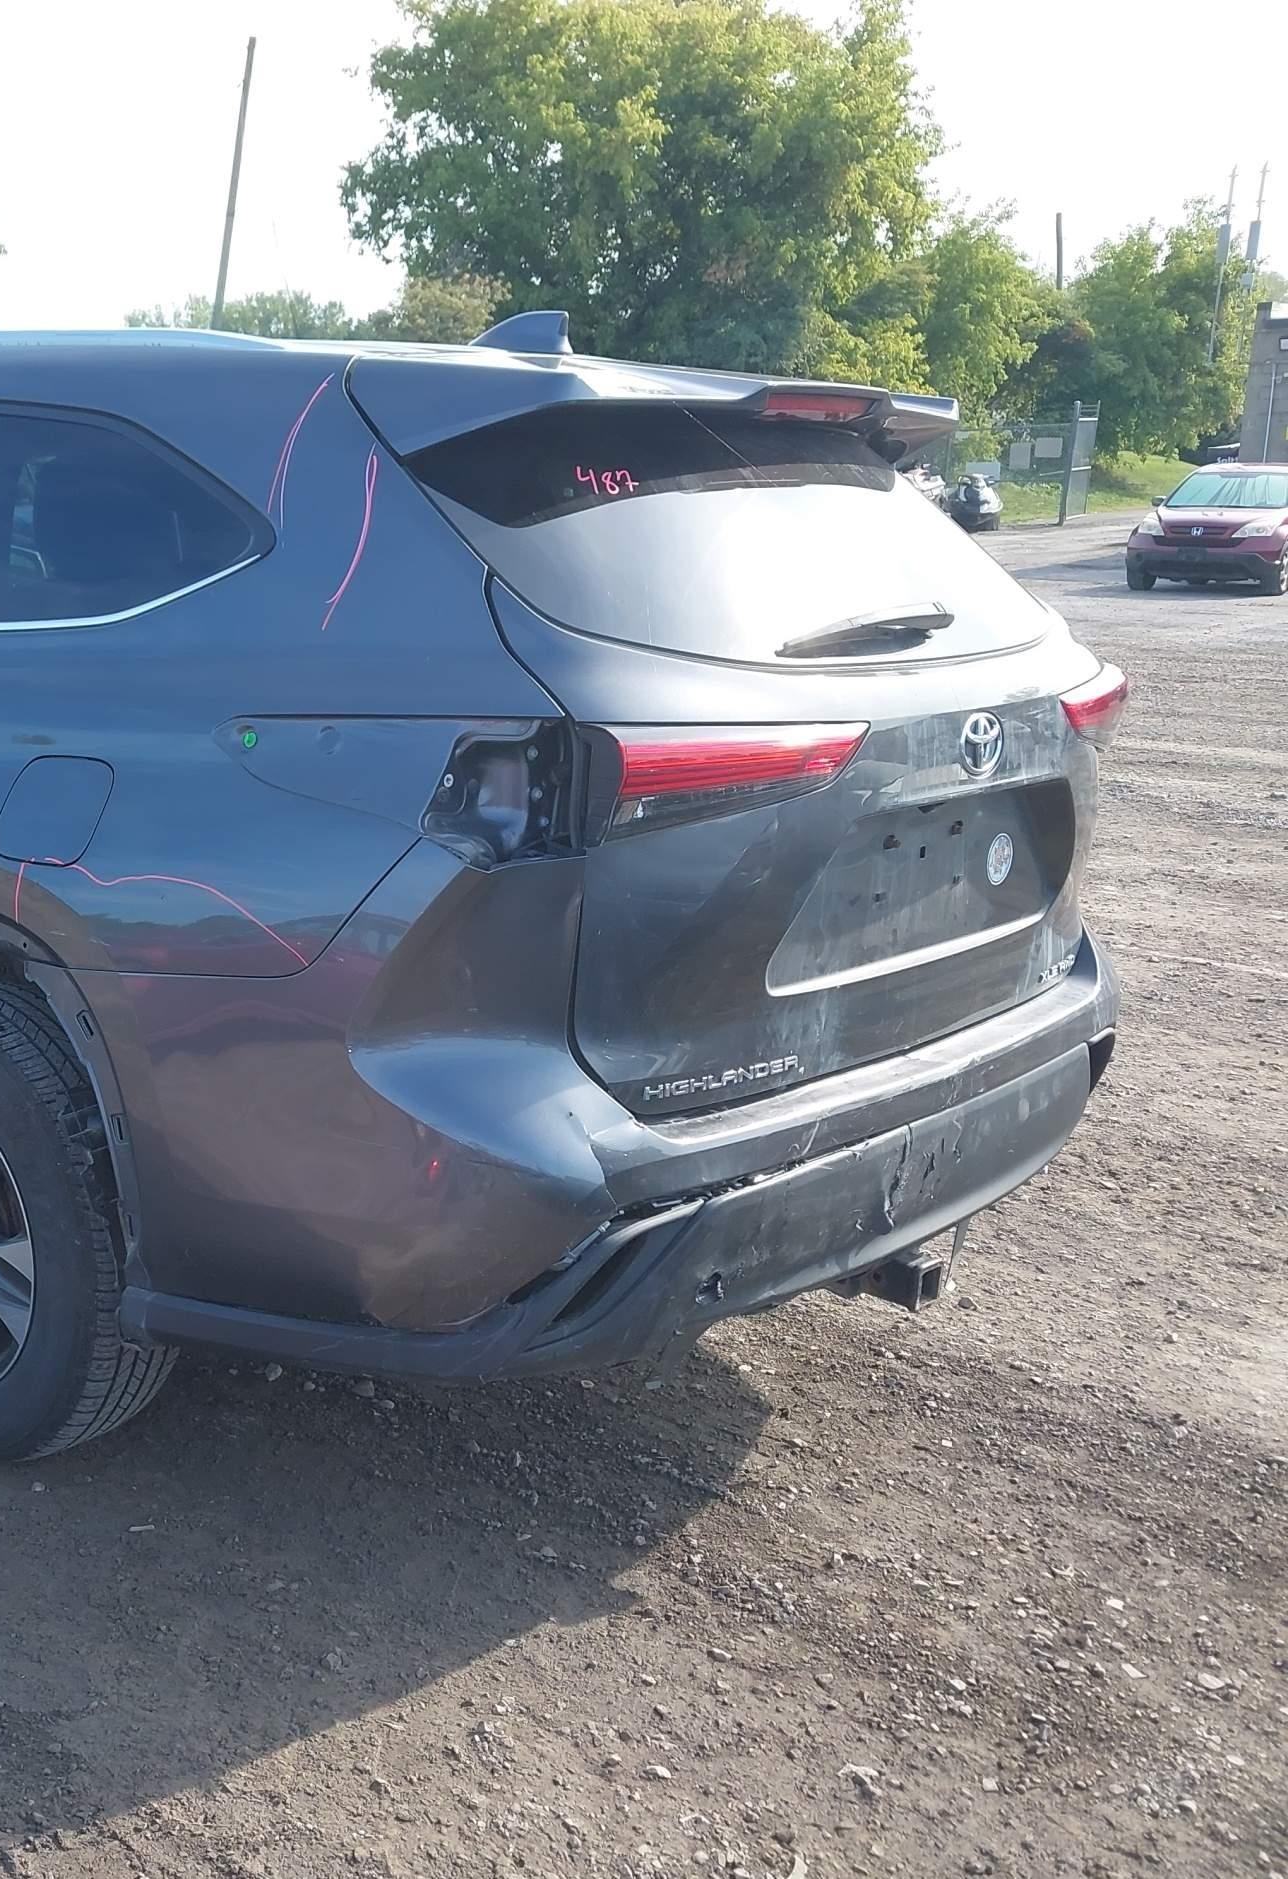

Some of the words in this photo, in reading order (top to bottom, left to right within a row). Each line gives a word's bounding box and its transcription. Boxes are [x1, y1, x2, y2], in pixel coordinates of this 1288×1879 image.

[576, 465, 639, 495] 487
[1040, 964, 1059, 983] XLE
[643, 1055, 799, 1101] HIGHLANDER
